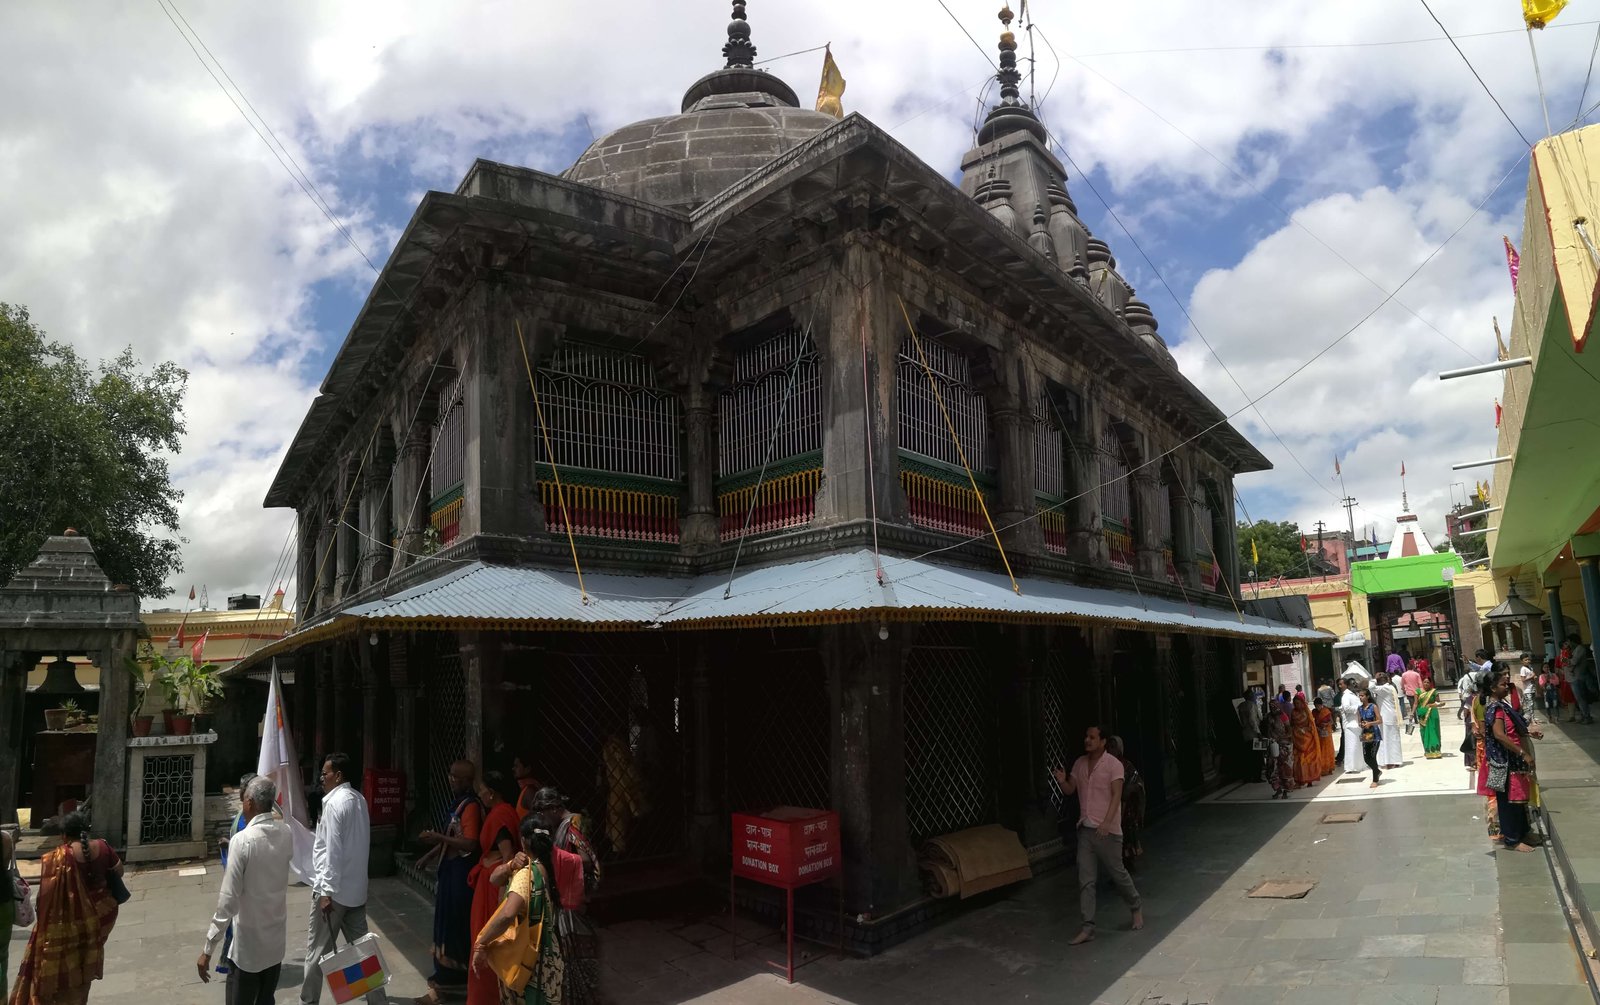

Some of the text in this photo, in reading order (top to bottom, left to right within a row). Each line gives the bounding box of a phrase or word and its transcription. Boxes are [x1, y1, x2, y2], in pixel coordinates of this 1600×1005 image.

[742, 855, 779, 874] DONATION BOX
[798, 856, 833, 876] DONATION BOX
